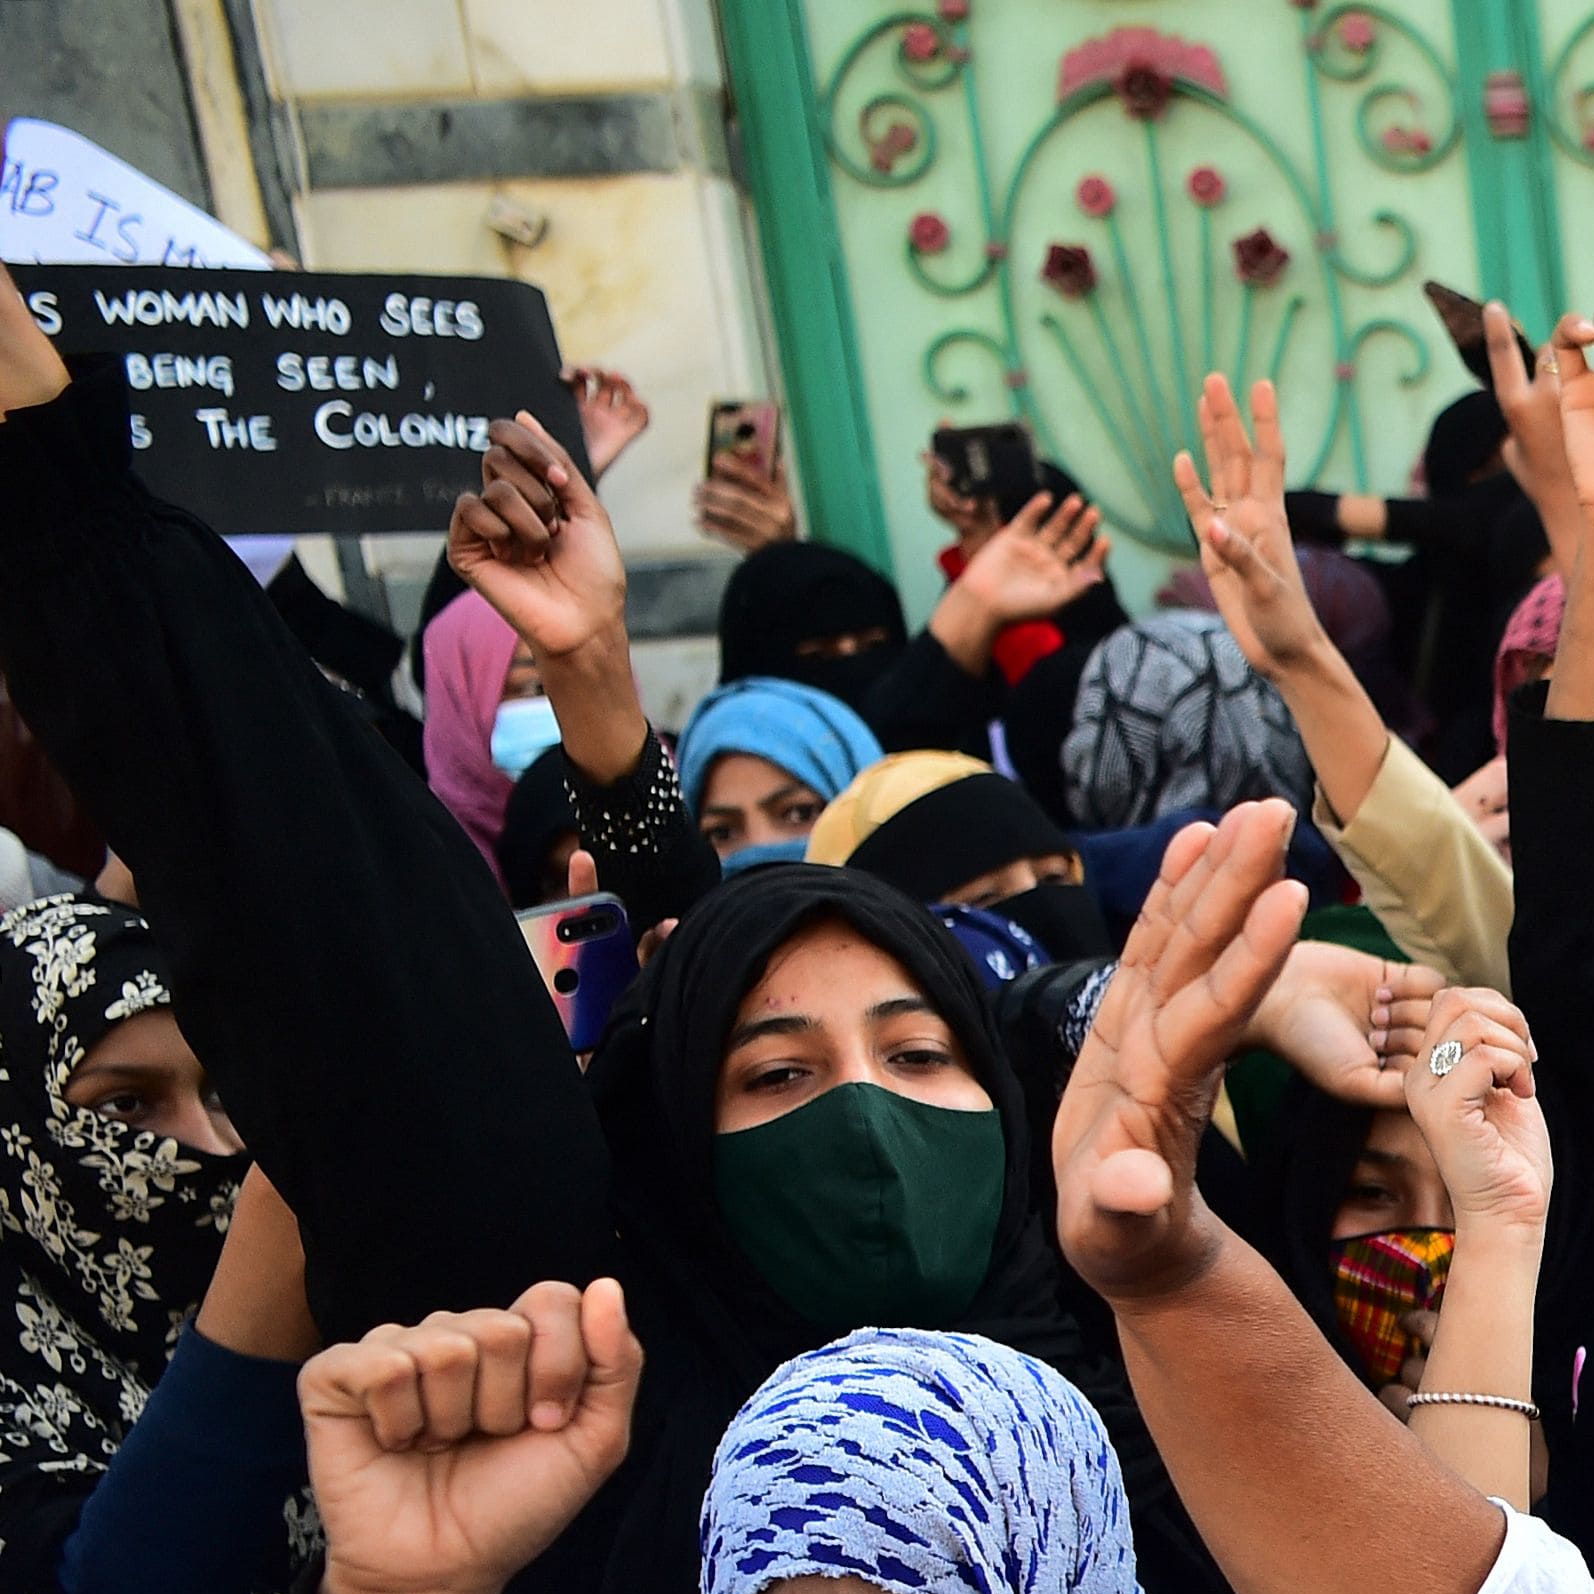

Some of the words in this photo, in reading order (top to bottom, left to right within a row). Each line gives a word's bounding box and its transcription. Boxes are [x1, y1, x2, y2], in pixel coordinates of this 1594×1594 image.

[74, 190, 143, 264] IS
[94, 289, 250, 330] WOMAN
[262, 290, 351, 336] WHO
[380, 293, 485, 340] SEES
[126, 352, 235, 397] BEING
